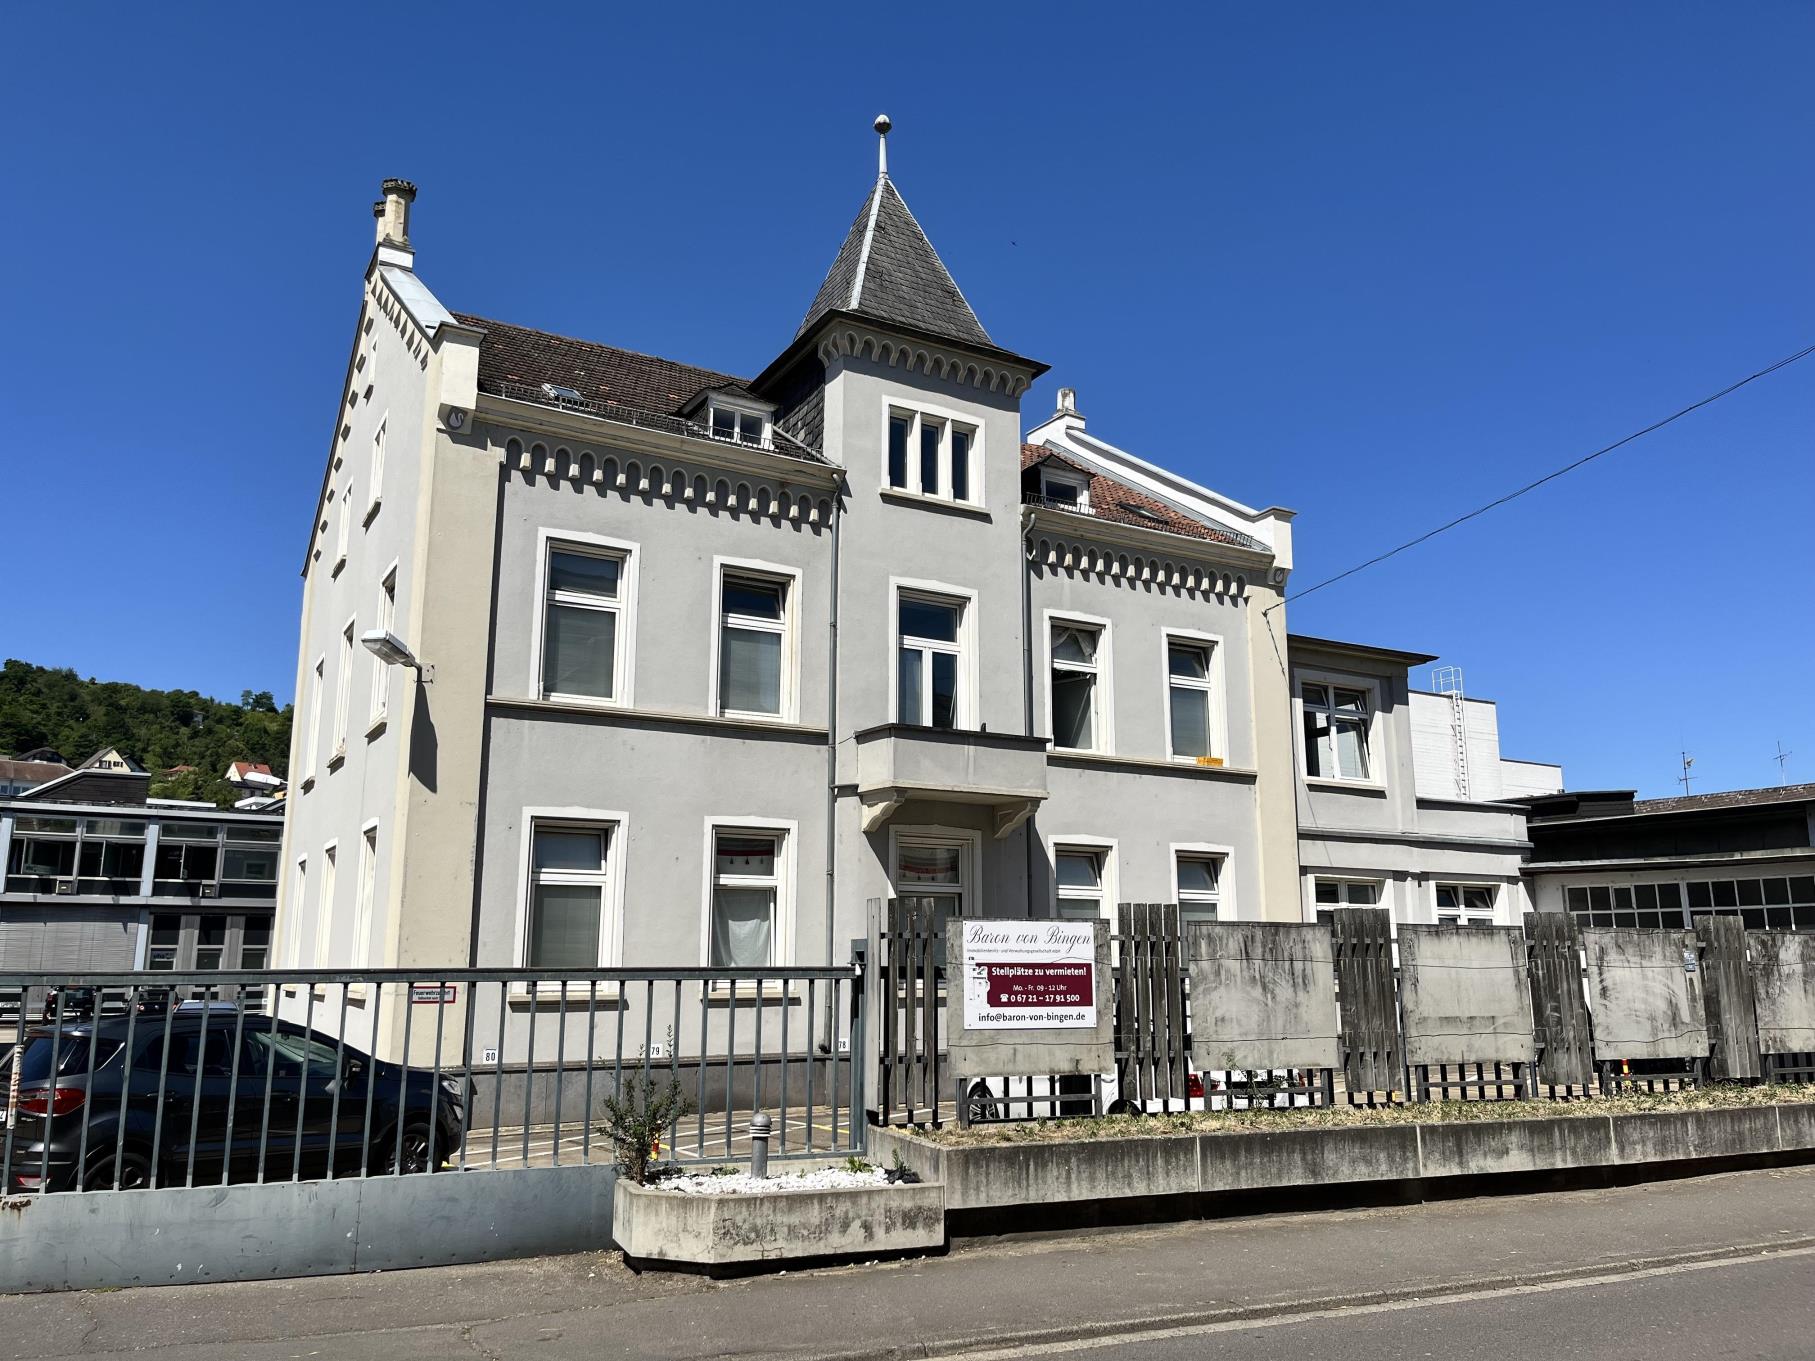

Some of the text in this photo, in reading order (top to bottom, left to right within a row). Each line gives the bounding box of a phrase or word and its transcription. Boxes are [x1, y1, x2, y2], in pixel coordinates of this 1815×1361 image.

[967, 925, 1090, 953] Baron von Bingen
[992, 967, 1087, 977] Stellplätze zu vermieten!
[1037, 984, 1045, 992] 09
[1017, 994, 1027, 1003] 67
[1045, 995, 1055, 1003] 17
[1056, 995, 1065, 1003] 91
[1067, 995, 1080, 1003] 500
[978, 1012, 1086, 1023] info@baron-von-bingen.de
[652, 1047, 660, 1055] 79
[485, 1052, 496, 1061] 80
